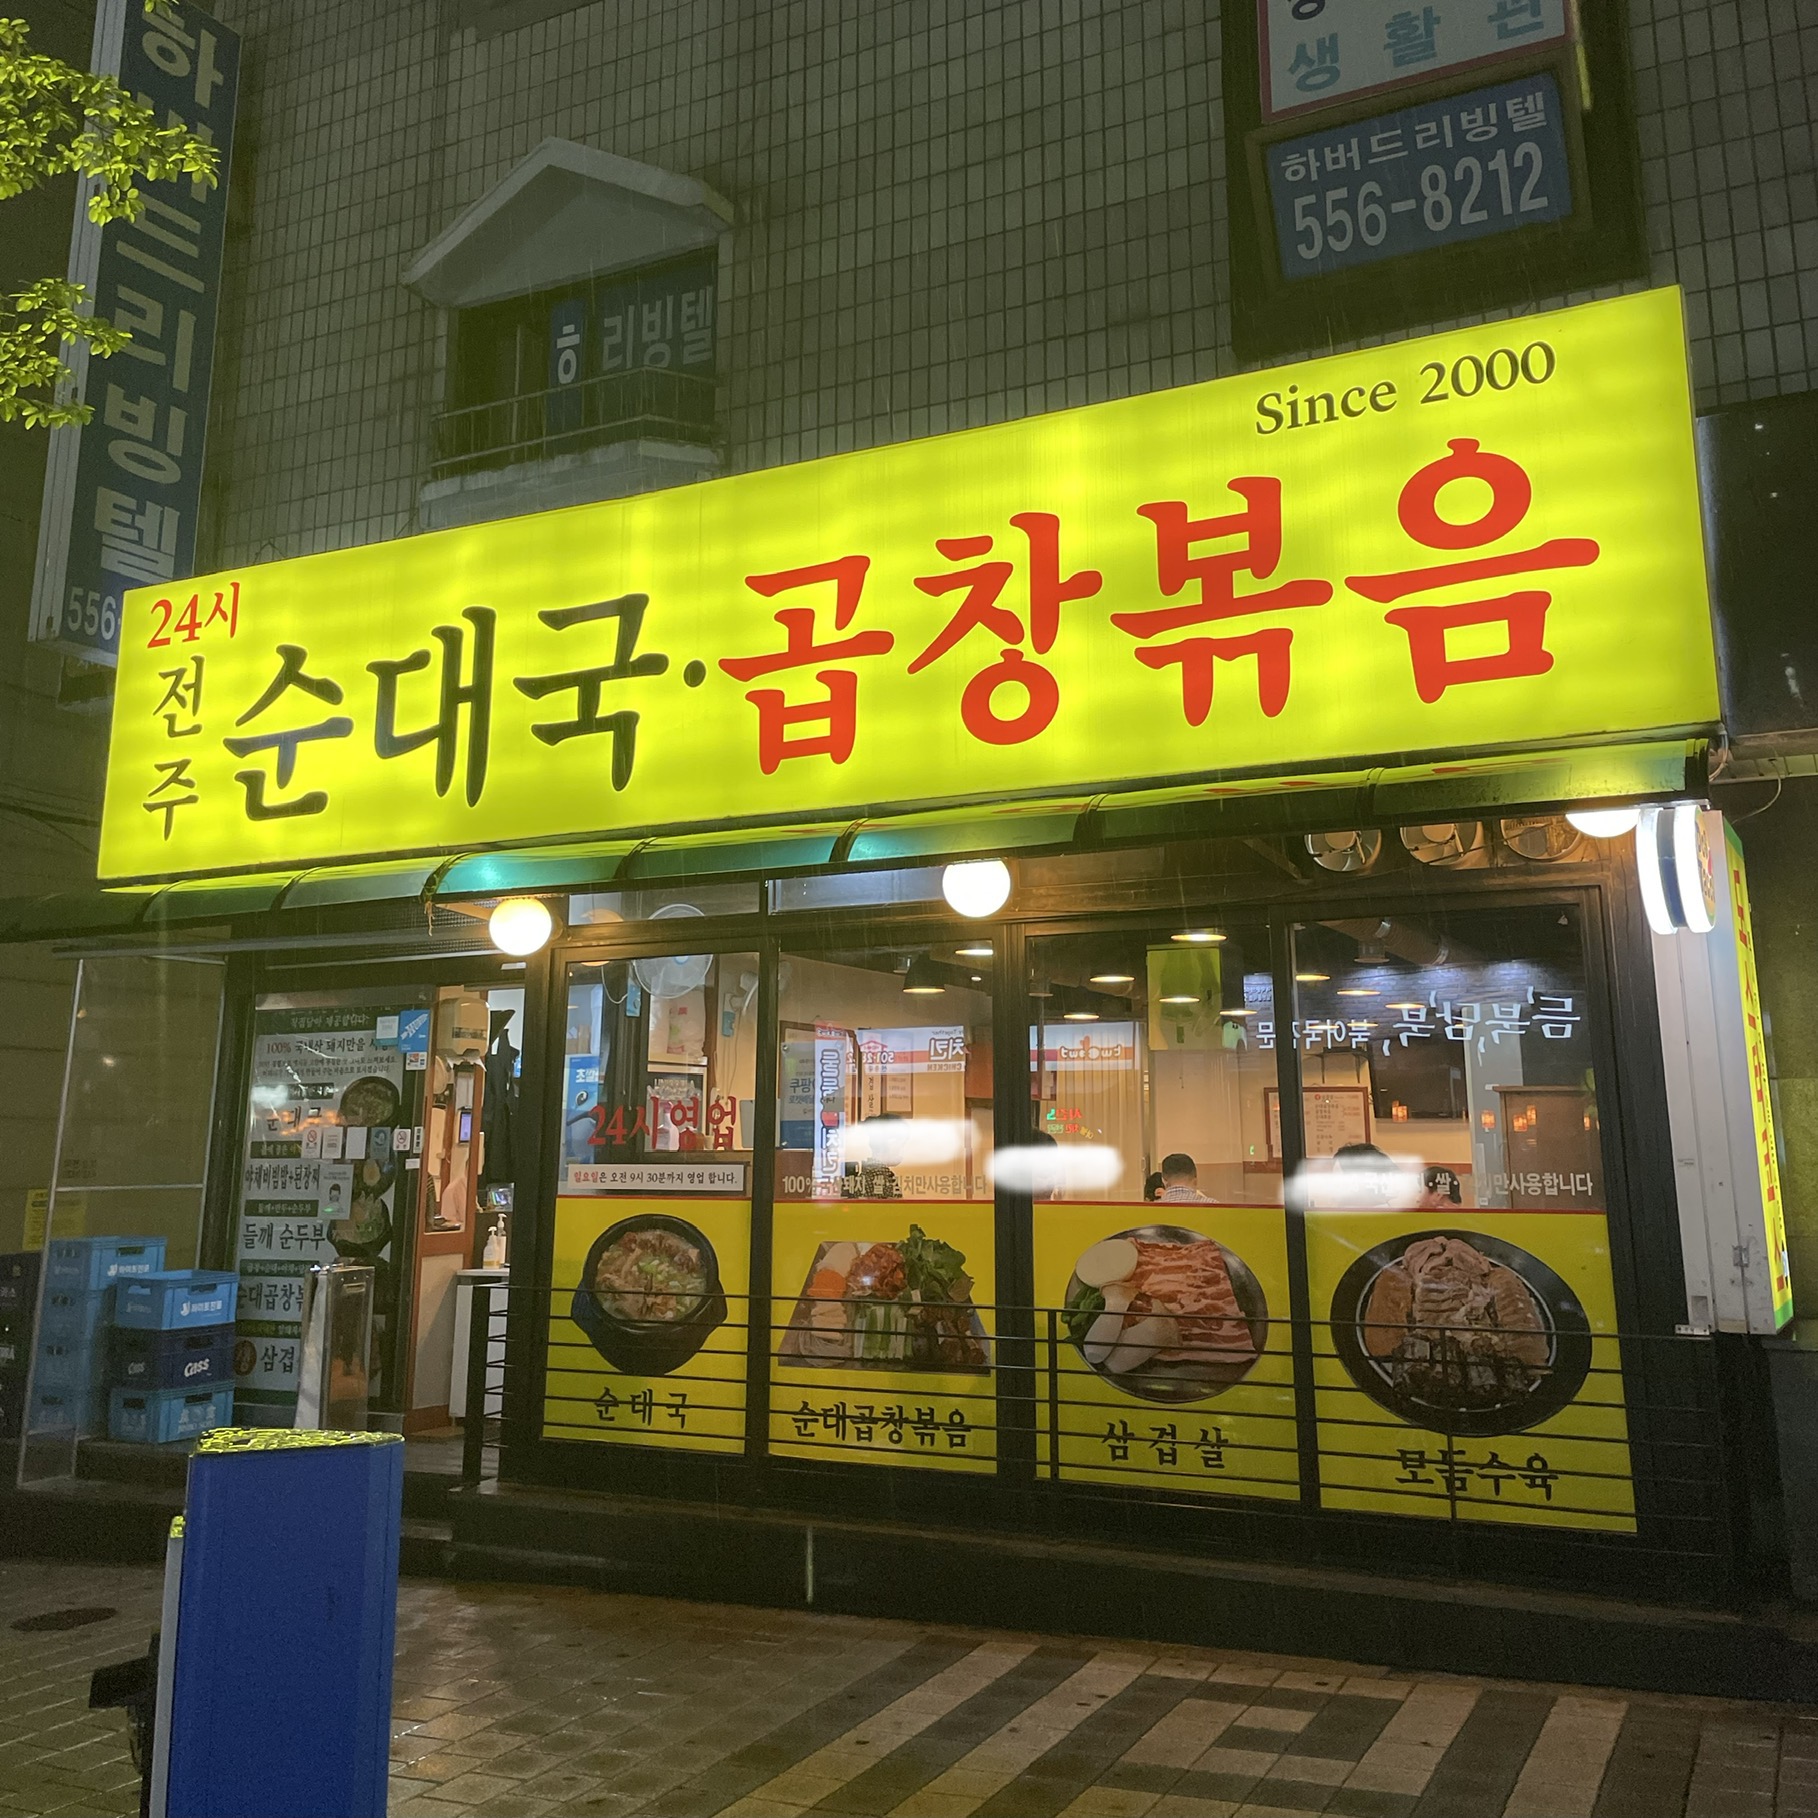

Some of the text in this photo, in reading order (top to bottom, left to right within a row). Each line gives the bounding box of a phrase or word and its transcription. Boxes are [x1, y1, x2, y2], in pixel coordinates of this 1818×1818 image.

[1281, 92, 1548, 182] 하버드리빙텔
[1295, 142, 1548, 261] 556-8212
[94, 3, 223, 580] 하드리빙텔
[602, 286, 713, 371] 리빙텔
[1256, 341, 1556, 435] Since 2000
[147, 582, 239, 648] 24시
[143, 655, 206, 841] 전주
[266, 1042, 291, 1053] 100%
[587, 1096, 736, 1150] 24시 영업
[574, 1171, 607, 1183] 일요일은
[610, 1171, 627, 1183] 오전
[630, 1172, 643, 1184] 9시
[646, 1171, 684, 1185] 30분까지
[687, 1172, 704, 1184] 영업
[243, 1222, 325, 1251] 들깨 순두부
[184, 1358, 210, 1378] Cass
[593, 1386, 690, 1429] 순대국
[791, 1401, 972, 1447] 순대곱창볶음
[1101, 1419, 1229, 1469] 삼겹살
[1395, 1446, 1560, 1501] 모듬수육
